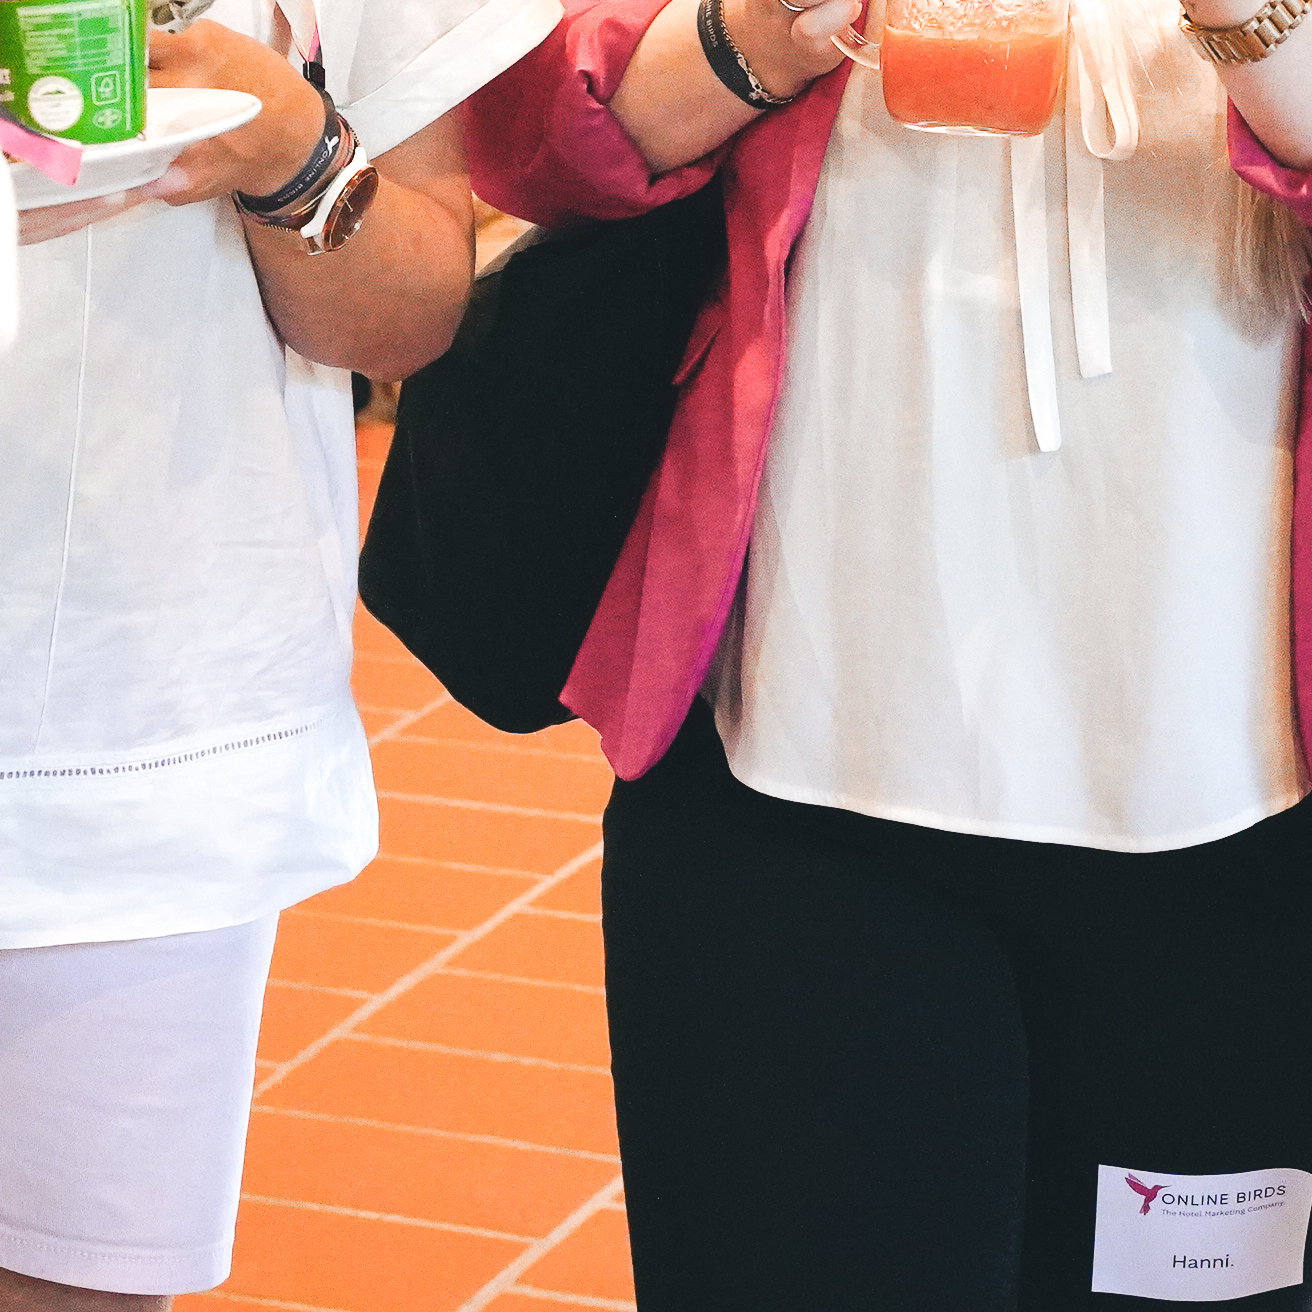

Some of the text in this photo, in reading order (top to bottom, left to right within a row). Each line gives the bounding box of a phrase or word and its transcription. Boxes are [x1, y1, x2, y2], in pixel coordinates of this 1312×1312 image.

[1161, 1185, 1286, 1206] ONLINE BIRDS
[1204, 1208, 1246, 1217] Marketing
[1172, 1254, 1235, 1269] Hanni.
